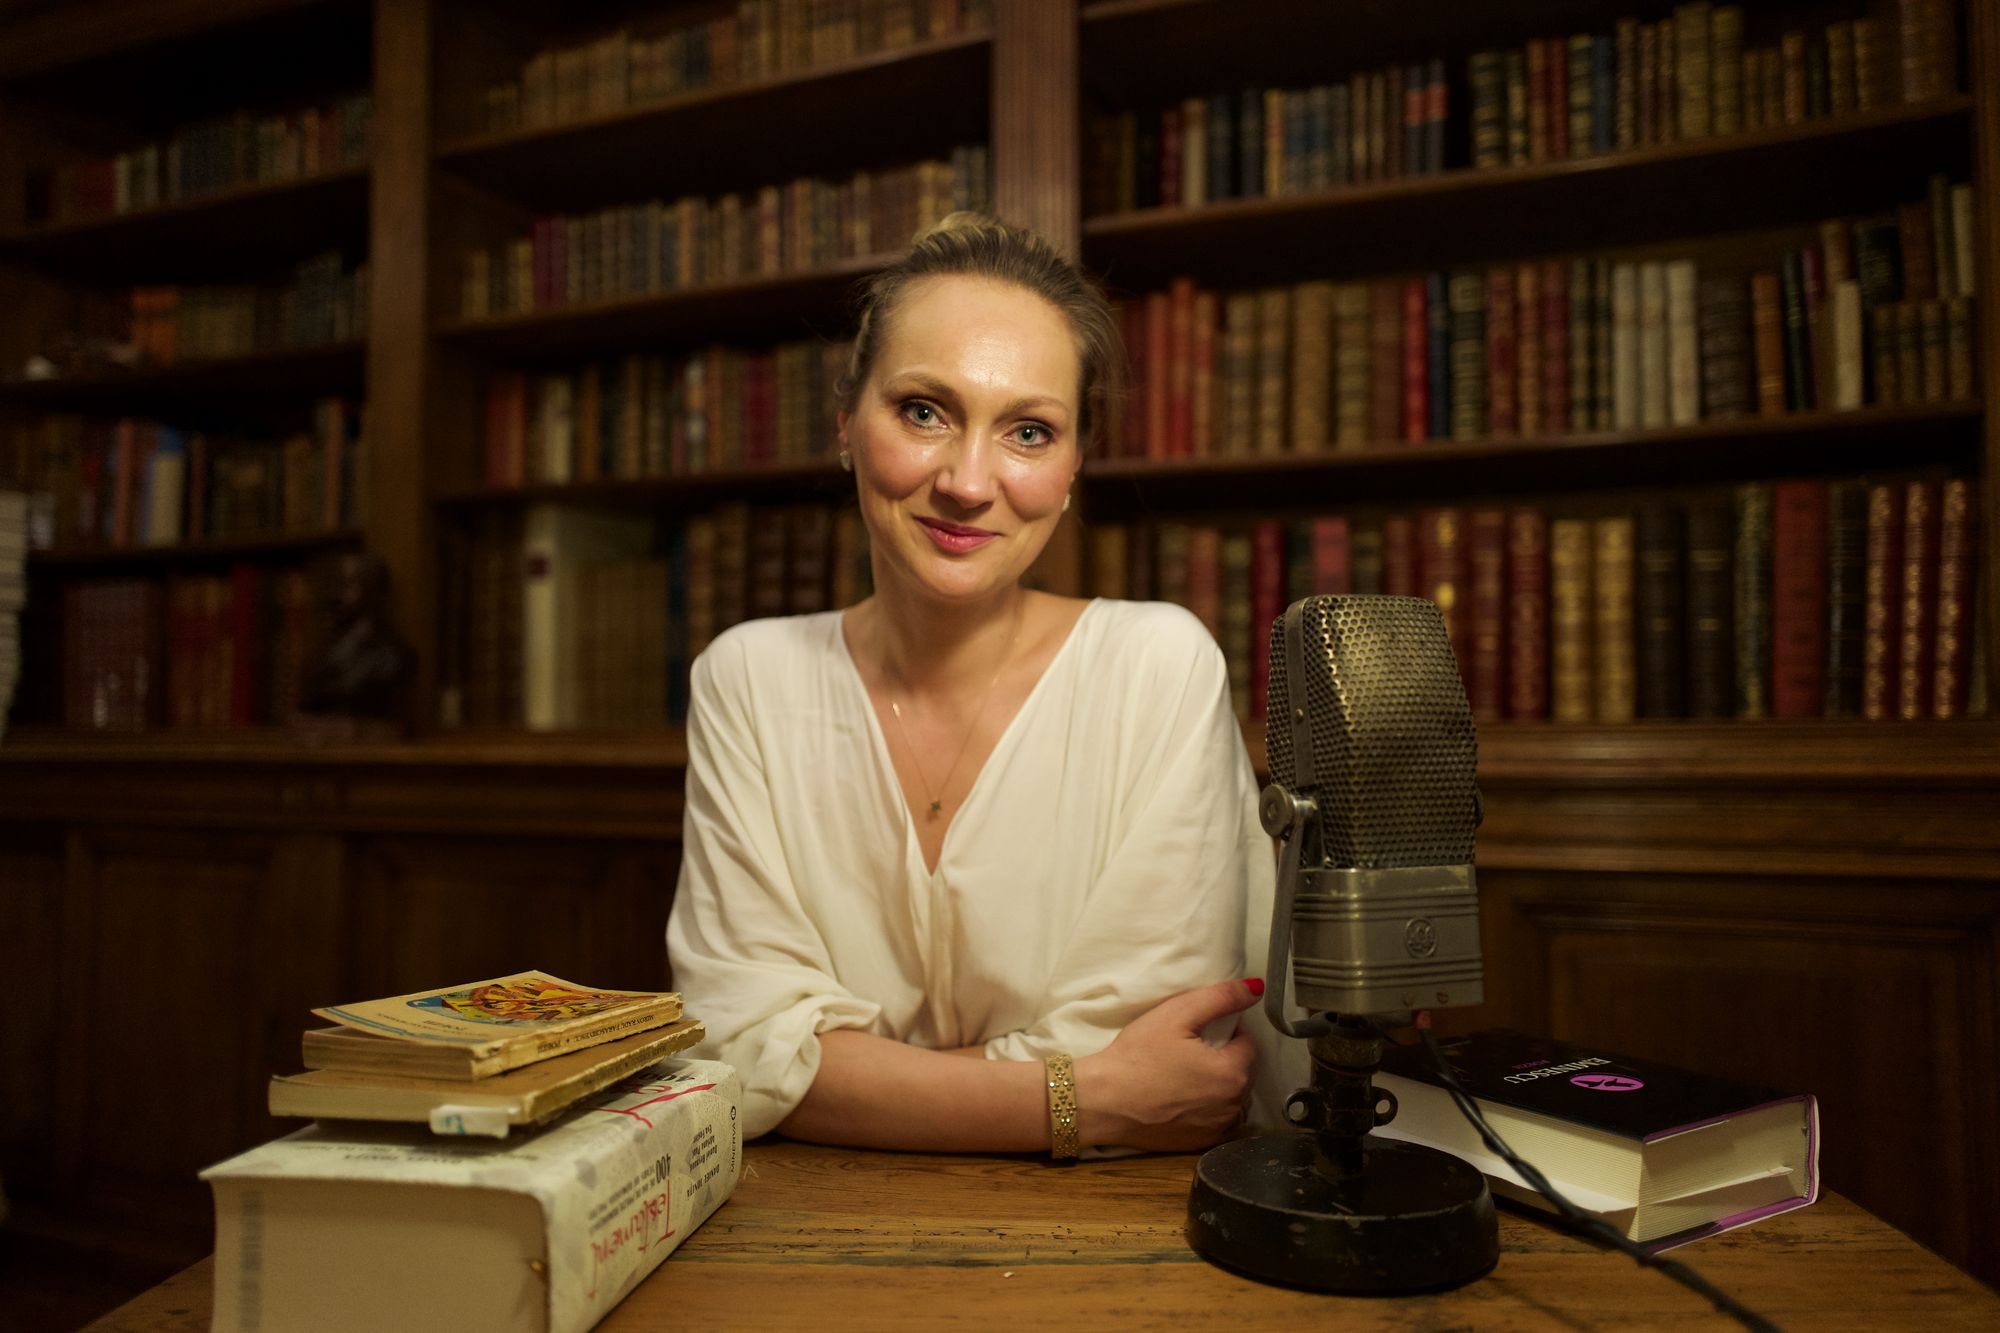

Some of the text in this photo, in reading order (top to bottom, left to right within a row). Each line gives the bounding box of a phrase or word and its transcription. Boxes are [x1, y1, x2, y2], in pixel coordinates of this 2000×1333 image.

[1504, 1057, 1612, 1084] EMINESCU
[656, 1153, 671, 1184] 400
[703, 1164, 720, 1184] DANIEL
[588, 1180, 675, 1299] Testament
